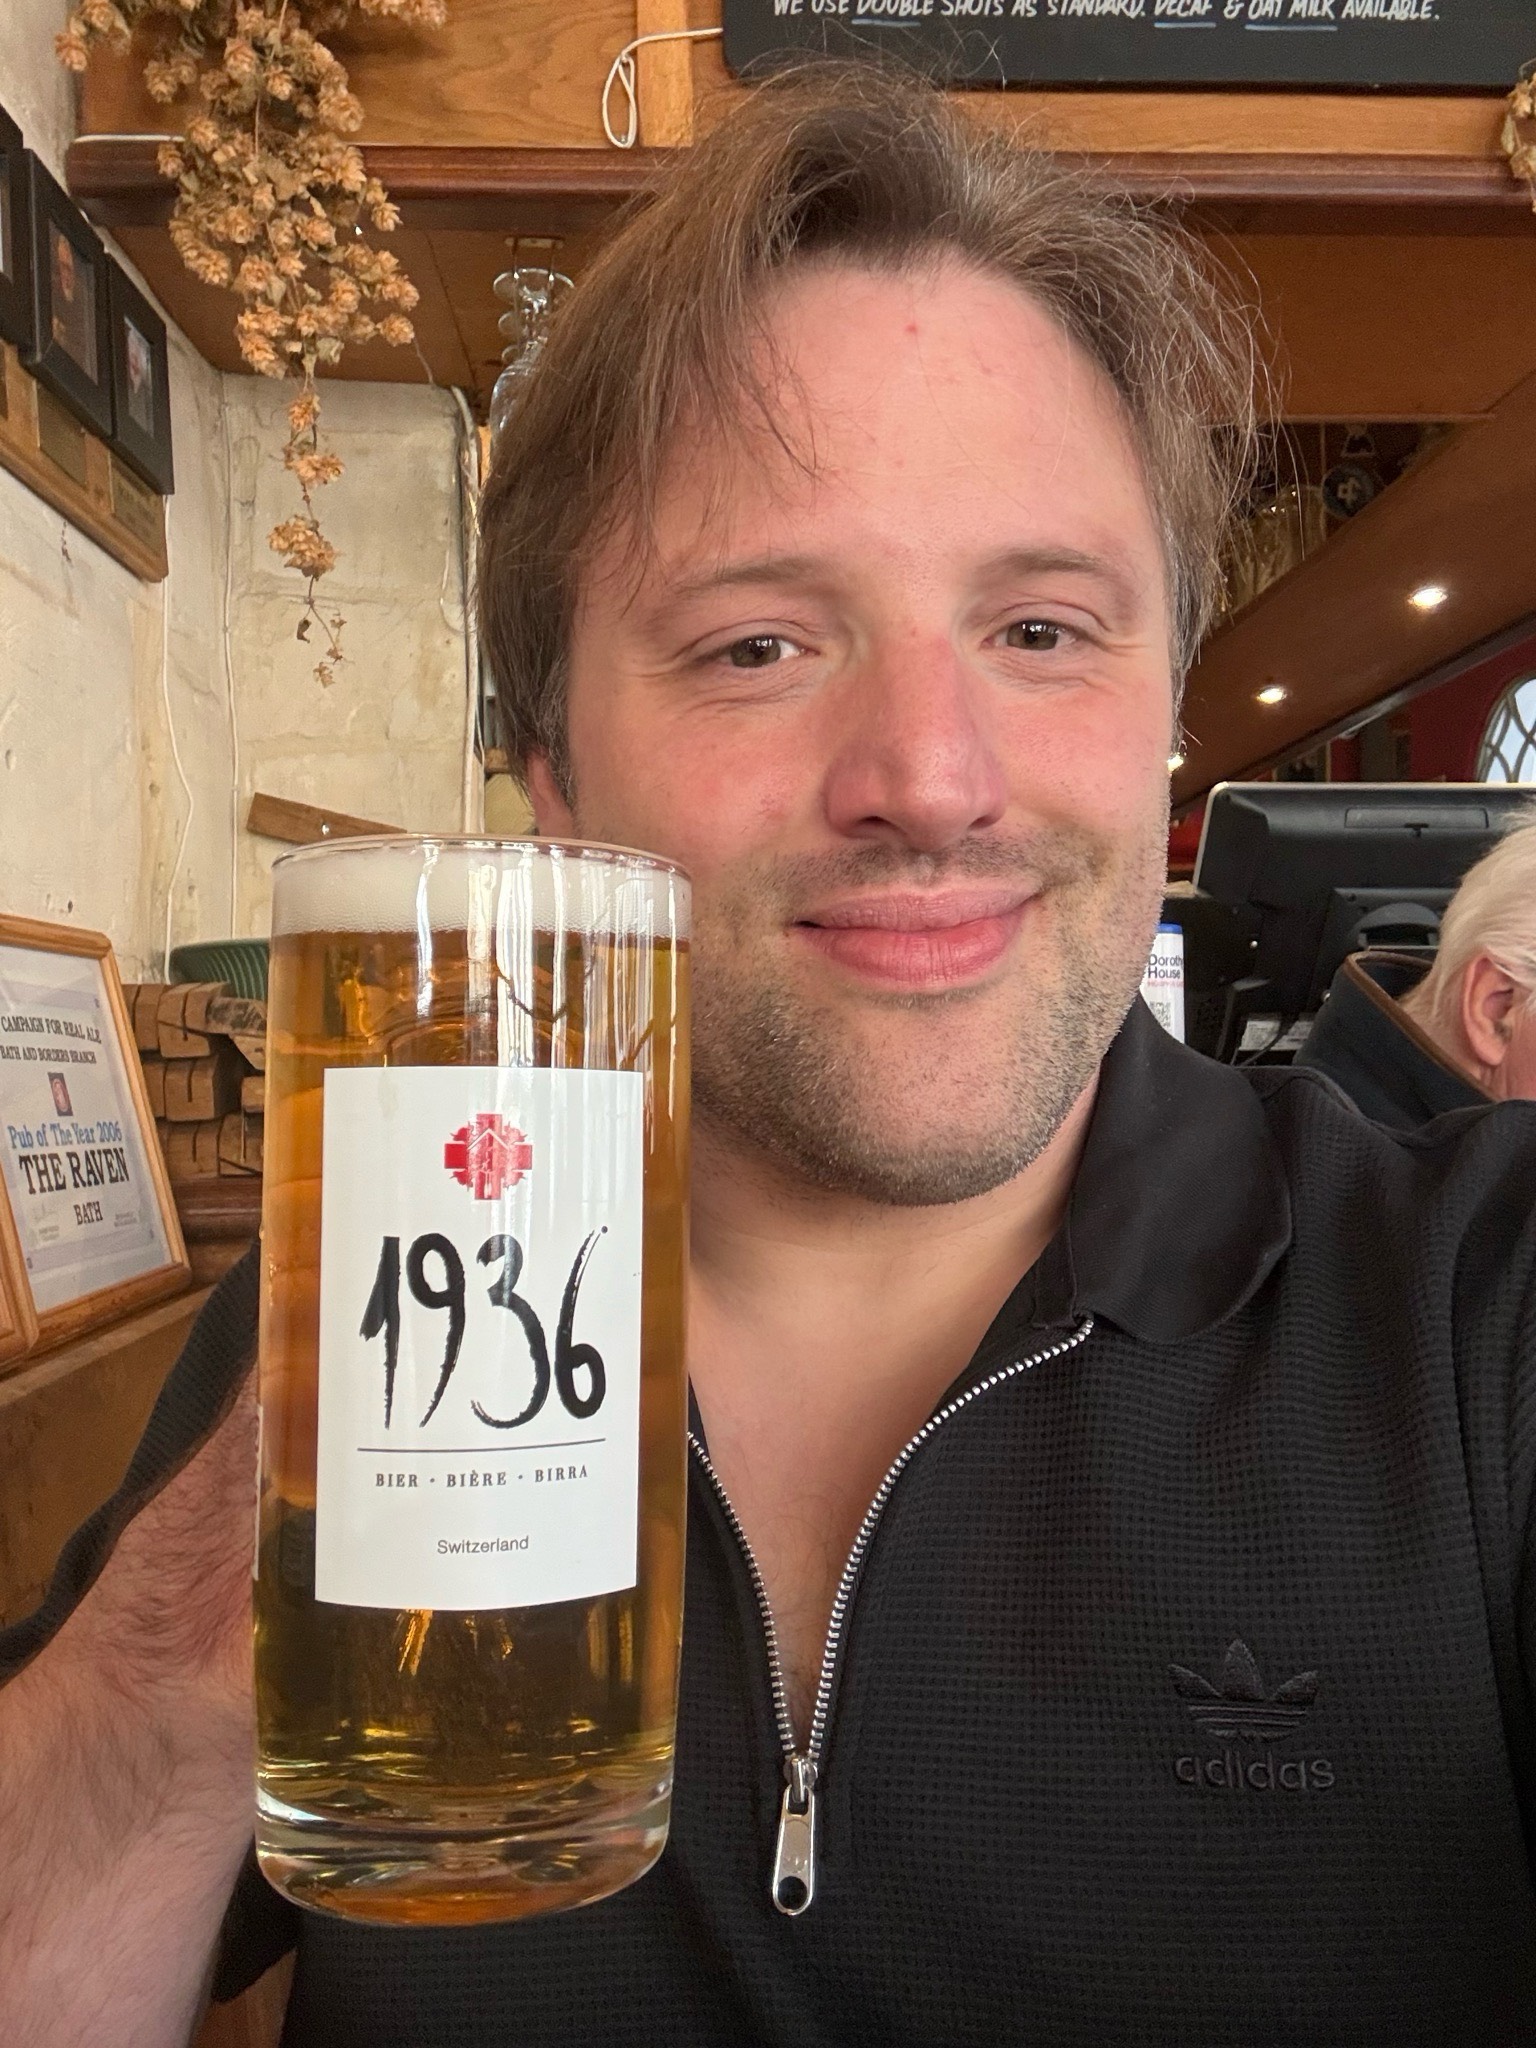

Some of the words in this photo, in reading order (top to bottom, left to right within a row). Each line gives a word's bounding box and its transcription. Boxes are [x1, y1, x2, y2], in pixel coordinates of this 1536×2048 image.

[774, 0, 803, 16] WE
[811, 0, 849, 15] USE
[856, 0, 933, 16] DOUBLE
[939, 0, 1003, 16] SHOTS
[1011, 0, 1038, 17] AS
[1047, 0, 1146, 19] STANDARD.
[1153, 0, 1213, 17] DECAF
[1223, 0, 1244, 19] &
[1247, 0, 1283, 19] OAT
[1287, 0, 1336, 20] MILK
[1341, 0, 1440, 20] AVAILABLE.
[1148, 966, 1181, 979] House
[0, 1016, 44, 1033] CAMPAIGN
[45, 1018, 63, 1034] FOR
[63, 1021, 85, 1039] REAL
[86, 1026, 102, 1044] ALE
[0, 1045, 21, 1060] BATH
[22, 1046, 37, 1060] AND
[7, 1124, 34, 1149] Pub
[36, 1123, 49, 1147] of
[49, 1123, 73, 1146] The
[71, 1122, 96, 1145] Year
[96, 1121, 123, 1142] 2006
[18, 1152, 67, 1195] THE
[66, 1147, 130, 1189] RAVEN
[73, 1201, 104, 1226] BATH
[359, 1226, 608, 1430] 1936
[375, 1473, 419, 1488] BIER
[446, 1470, 507, 1488] BIÈRE
[534, 1465, 588, 1483] BIRRA
[437, 1536, 529, 1555] Switzerland
[1175, 1750, 1336, 1790] adidas
